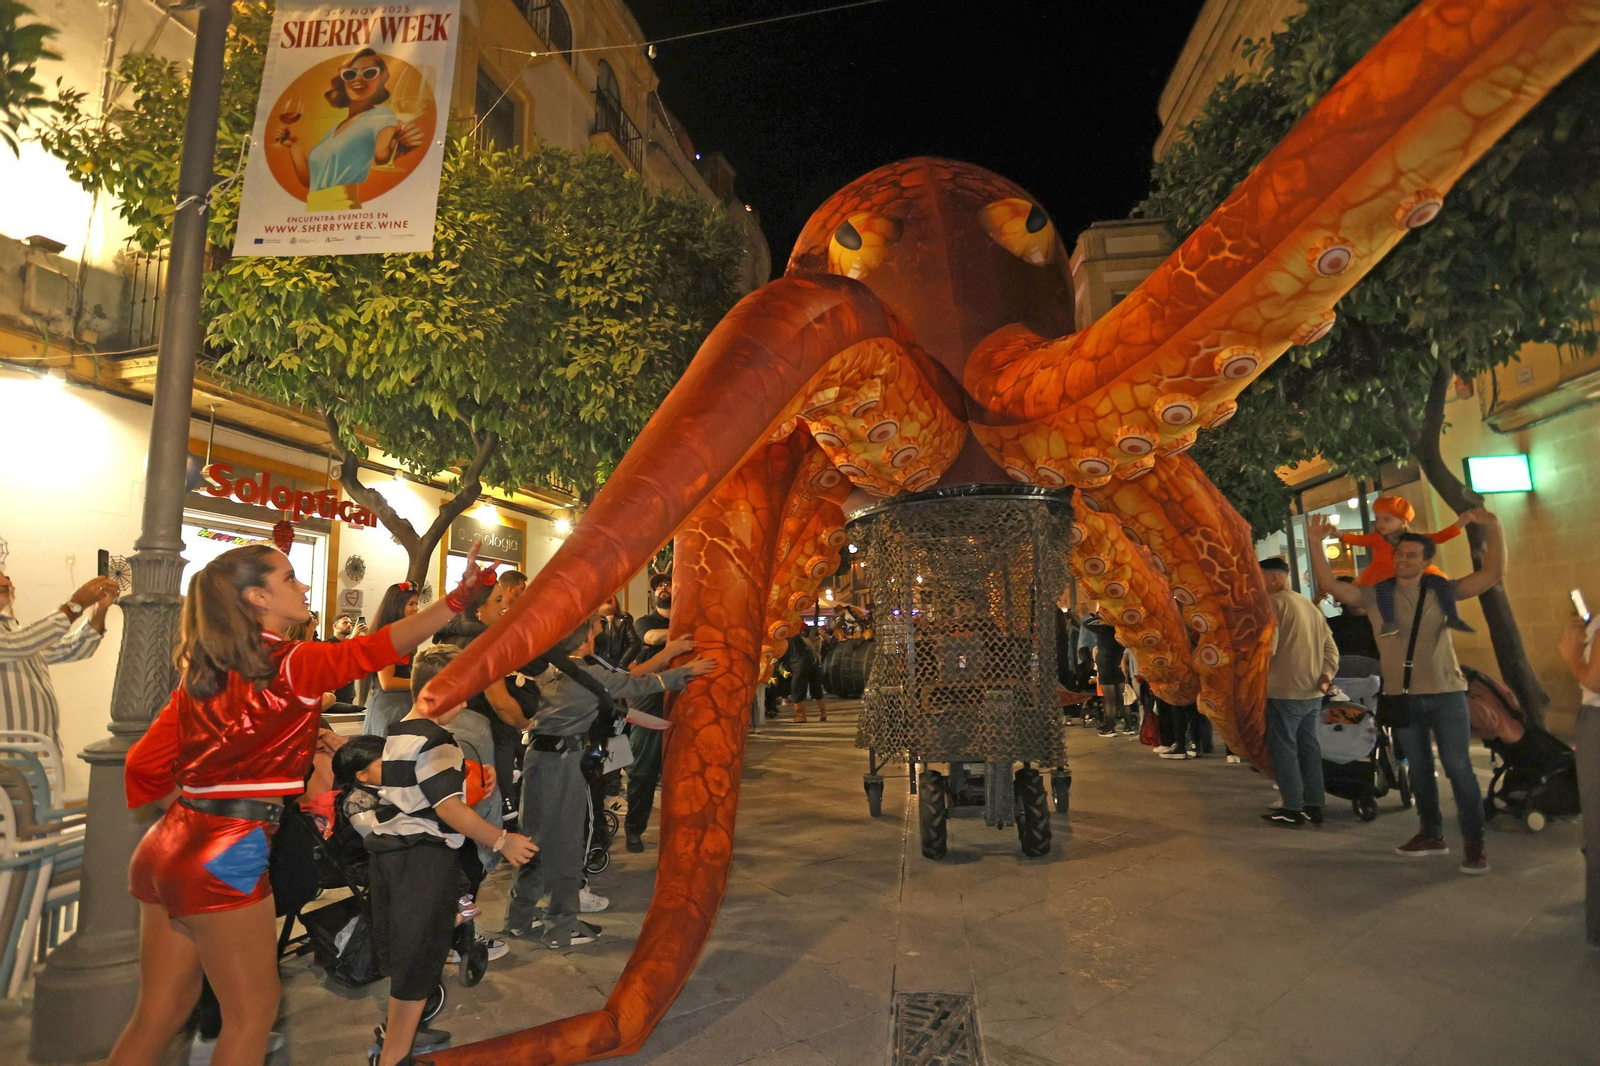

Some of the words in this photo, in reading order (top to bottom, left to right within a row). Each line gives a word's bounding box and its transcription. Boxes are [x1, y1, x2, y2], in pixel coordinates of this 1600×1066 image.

[350, 8, 376, 16] NOV
[381, 5, 411, 15] 2025
[280, 17, 378, 49] SHERRY
[379, 13, 452, 44] WEEK
[286, 215, 335, 224] ENCUENTRA
[337, 212, 374, 221] EVENTOS
[377, 212, 389, 220] EN
[264, 220, 409, 234] WWW.SHERRYWEEK.WINE
